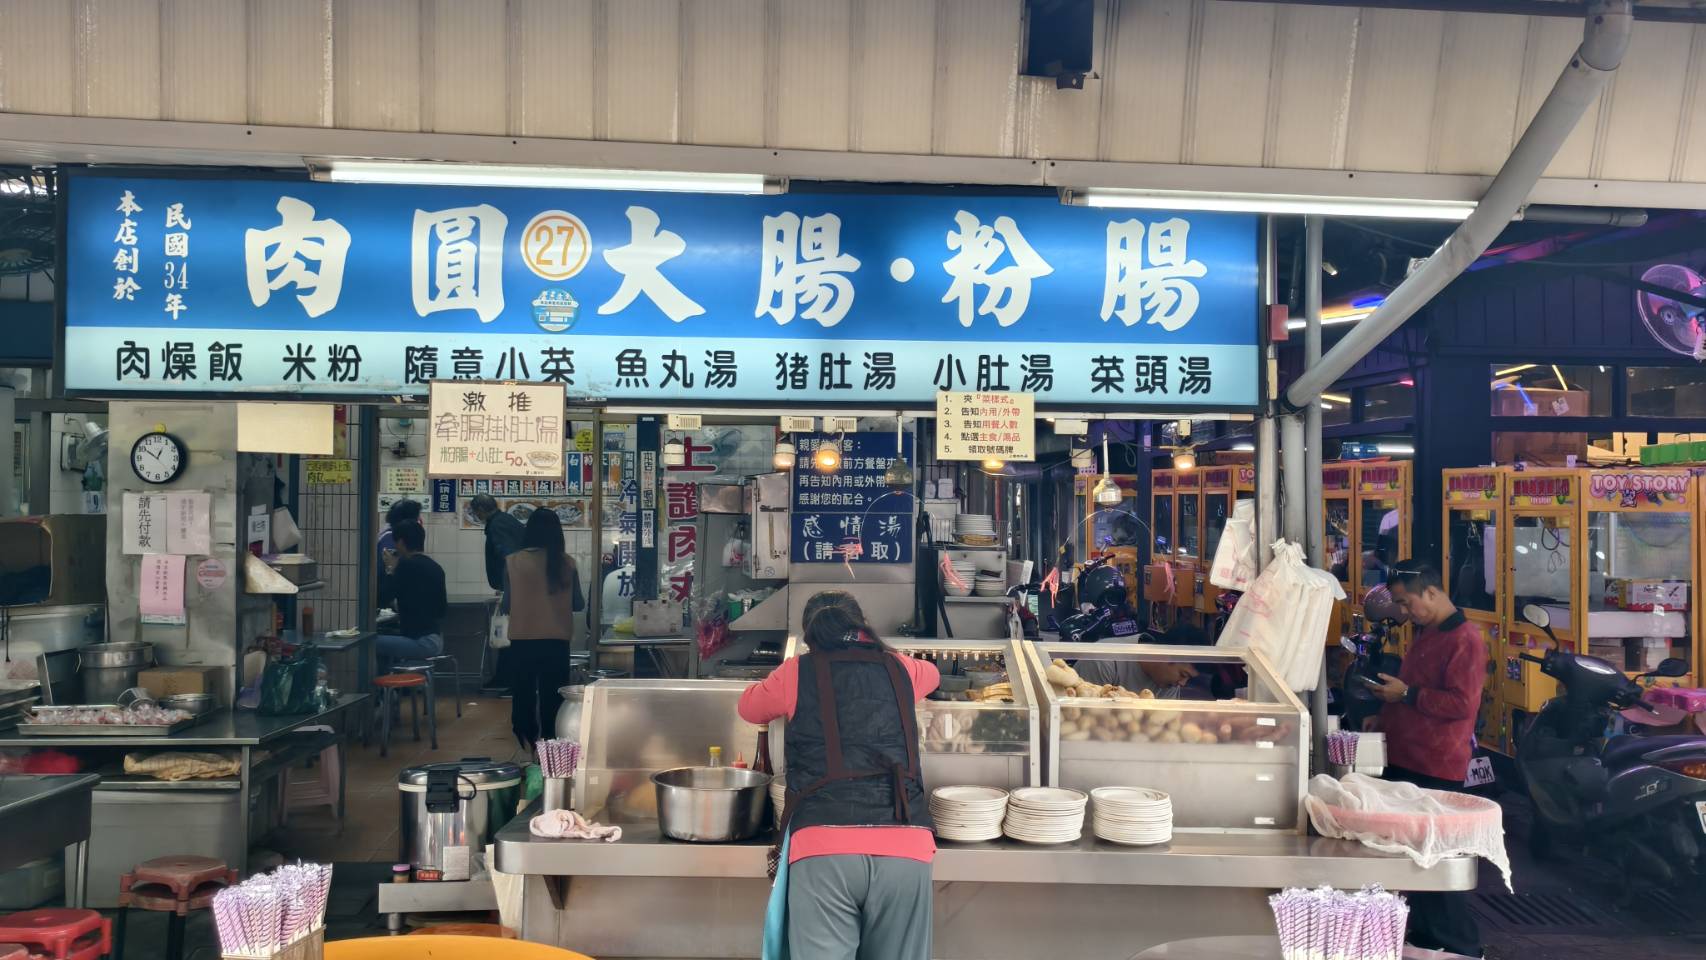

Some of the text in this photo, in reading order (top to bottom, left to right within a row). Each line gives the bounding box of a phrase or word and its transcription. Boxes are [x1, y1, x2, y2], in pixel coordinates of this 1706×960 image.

[113, 190, 143, 302] 本店創於
[163, 203, 192, 320] 民國34年
[535, 225, 577, 266] 27
[116, 340, 1212, 395] 肉燥飯 米粉 隨意小菜 魚丸湯 猪肚湯 小肚湯 菜頭湯
[1591, 475, 1689, 492] TOY STORY
[138, 496, 152, 547] 請先付款
